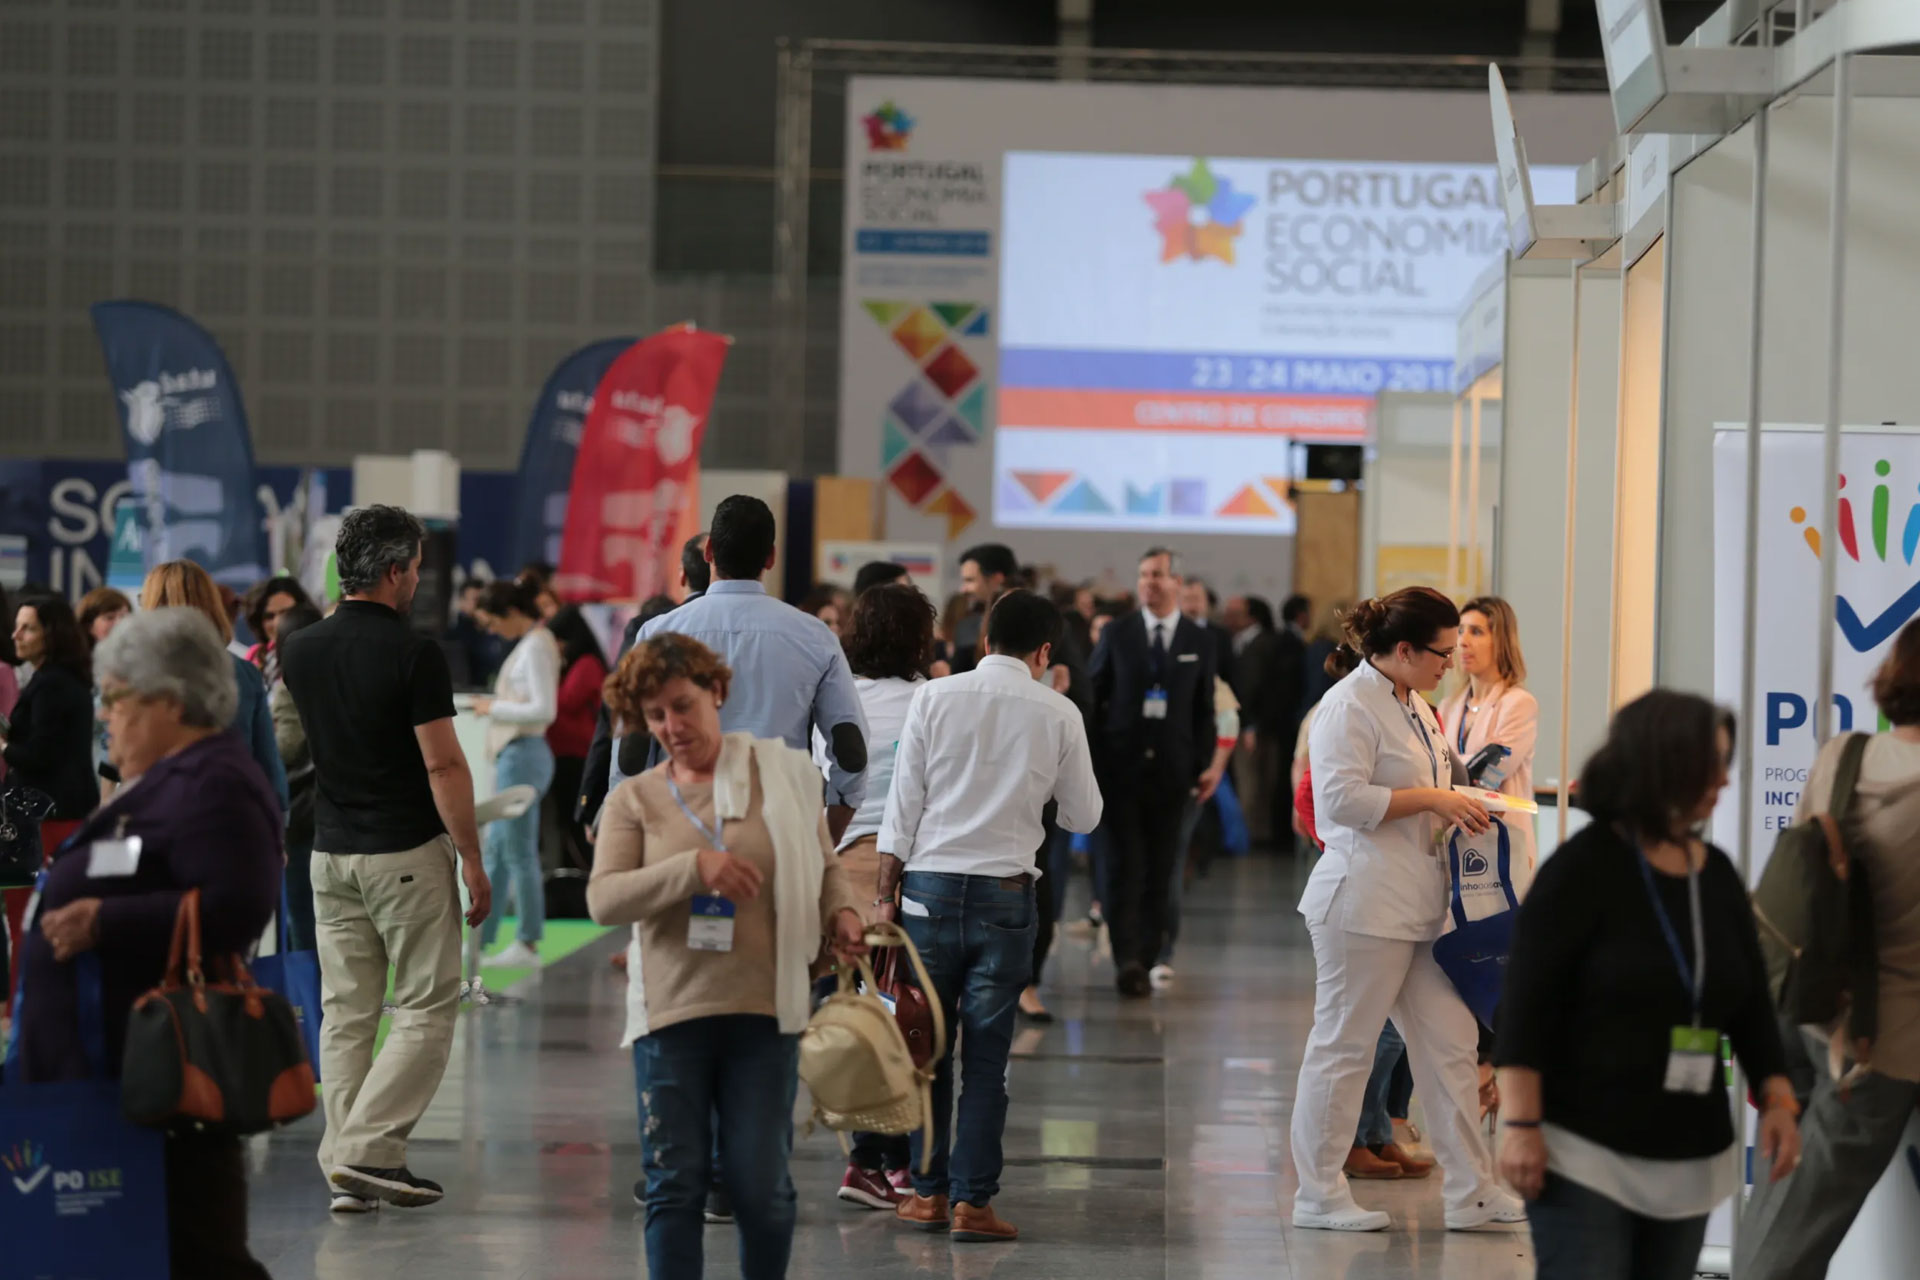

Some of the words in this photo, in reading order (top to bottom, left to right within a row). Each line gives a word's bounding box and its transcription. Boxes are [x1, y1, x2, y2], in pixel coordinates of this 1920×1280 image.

[1264, 254, 1428, 297] SOCIAL
[1248, 359, 1289, 390] 24
[1292, 361, 1383, 393] MAIO
